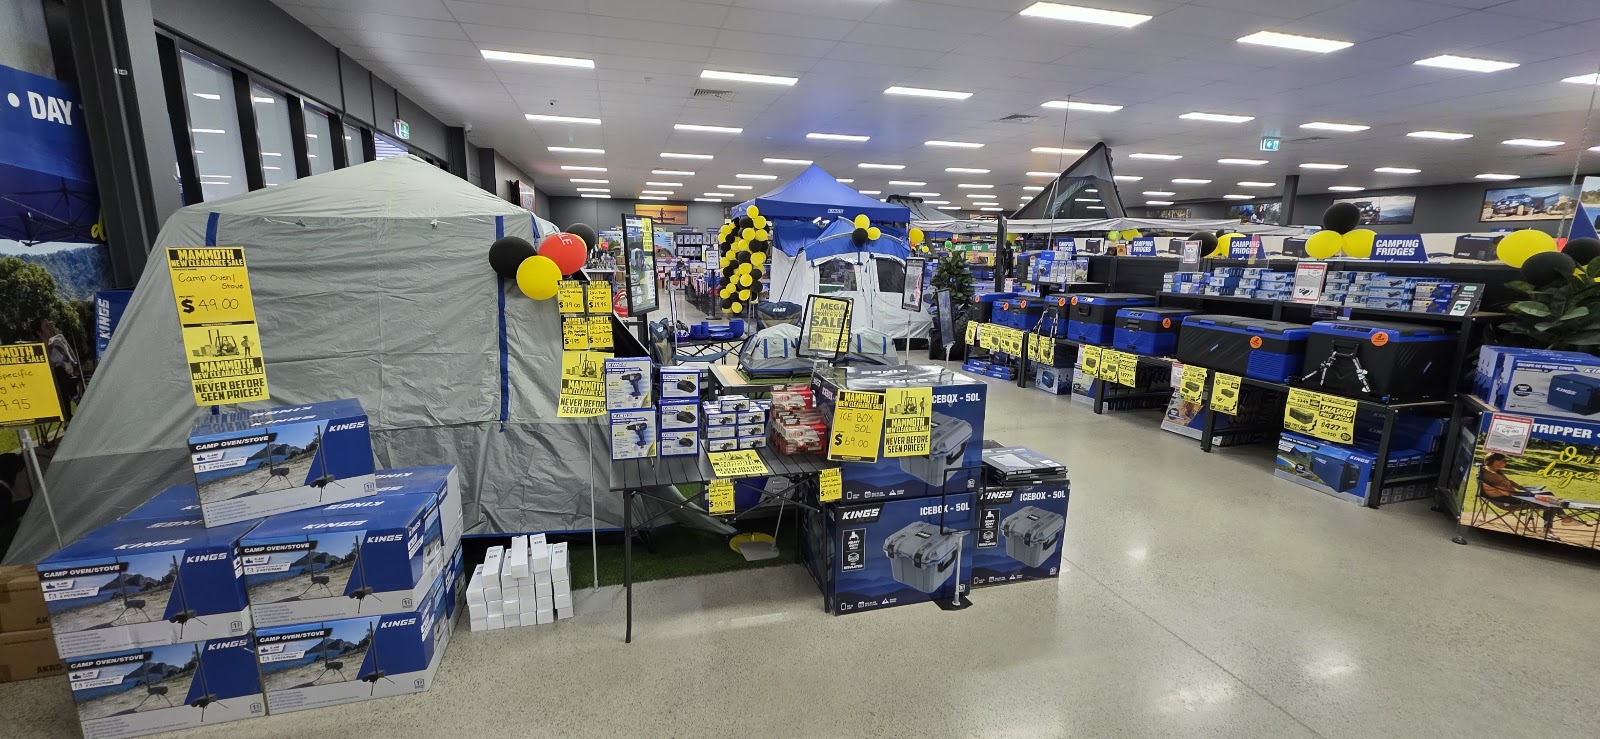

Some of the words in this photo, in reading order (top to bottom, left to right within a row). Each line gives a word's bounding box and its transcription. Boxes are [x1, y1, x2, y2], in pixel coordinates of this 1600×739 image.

[27, 91, 73, 126] DAY
[1375, 239, 1419, 249] CAMPING
[177, 249, 235, 260] MAMMOTH
[1375, 247, 1415, 257] FRIDGES
[171, 259, 188, 267] NEW
[188, 259, 227, 267] CLEARANCE
[227, 258, 244, 266] SALE
[178, 272, 207, 284] Camp
[181, 298, 195, 314] $
[820, 303, 846, 311] MEGA
[98, 298, 111, 339] KINGS
[811, 315, 851, 329] SALE
[27, 354, 46, 363] SALE
[199, 358, 255, 373] MAMMOTH
[0, 369, 34, 380] pecific
[192, 371, 208, 380] NEW
[209, 368, 245, 378] CLEARANCE
[245, 366, 263, 375] SALE
[194, 380, 227, 393] NEVER
[229, 378, 265, 391] BEFORE
[568, 379, 605, 392] MAMMOTH
[201, 390, 225, 402] SEEN
[227, 388, 263, 400] PRICES!
[844, 391, 880, 403] MAMMOTH
[932, 393, 958, 404] CEBOX
[965, 392, 981, 402] 50L
[561, 398, 583, 407] NEVER
[584, 399, 606, 408] BEFOR
[838, 400, 849, 408] NEW
[562, 405, 579, 414] SEEN
[1320, 404, 1354, 418] SMASHED
[839, 412, 852, 421] ICE
[856, 413, 874, 422] BOX
[891, 417, 925, 428] MAMMOTH
[328, 421, 367, 433] KINGS
[1532, 423, 1593, 439] TRIPPER
[195, 442, 220, 451] CAMP
[220, 435, 270, 448] OVEN/STOVE
[834, 432, 843, 446] $
[886, 436, 906, 446] NEVER
[906, 434, 929, 443] BEFORE
[887, 445, 903, 453] SEEN
[903, 443, 926, 453] PRICES!
[1559, 446, 1590, 465] On
[1020, 492, 1047, 502] ICEBOX
[1052, 490, 1066, 499] 50L
[841, 507, 880, 520] KINGS
[955, 502, 971, 512] 50L
[301, 519, 369, 530] KINGS
[366, 534, 403, 544] KINGS
[244, 546, 265, 554] CAMP
[266, 542, 310, 552] OVEN/STOVE
[186, 552, 228, 563] KINGS
[69, 564, 120, 576] OVEN/STOVE
[380, 618, 417, 629] KINGS
[259, 634, 280, 643] CAMP
[281, 630, 325, 641] OVEN/STOVE
[207, 638, 249, 651] KINGS
[70, 661, 94, 669] CAMP
[95, 654, 144, 666] OVEN/STOVE
